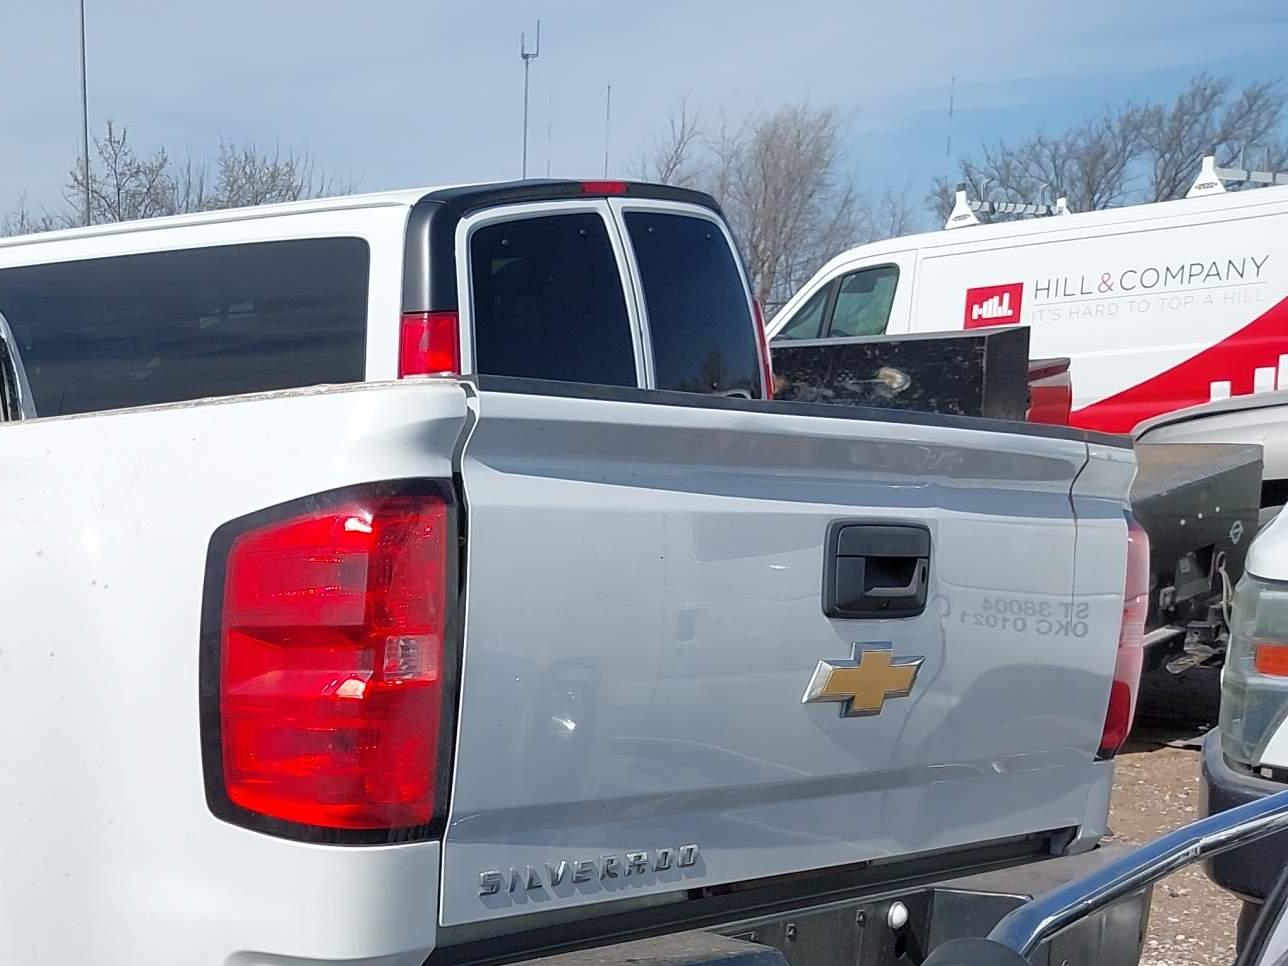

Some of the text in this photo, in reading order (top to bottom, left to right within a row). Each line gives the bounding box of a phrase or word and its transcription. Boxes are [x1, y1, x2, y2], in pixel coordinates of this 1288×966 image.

[1034, 254, 1270, 300] HILL&COMPANY
[1069, 302, 1120, 321] HARD
[1127, 299, 1151, 313] TO
[1160, 295, 1194, 311] TOP
[1202, 294, 1215, 306] A
[1224, 287, 1266, 305] HILL
[478, 842, 701, 897] SILVERADO
